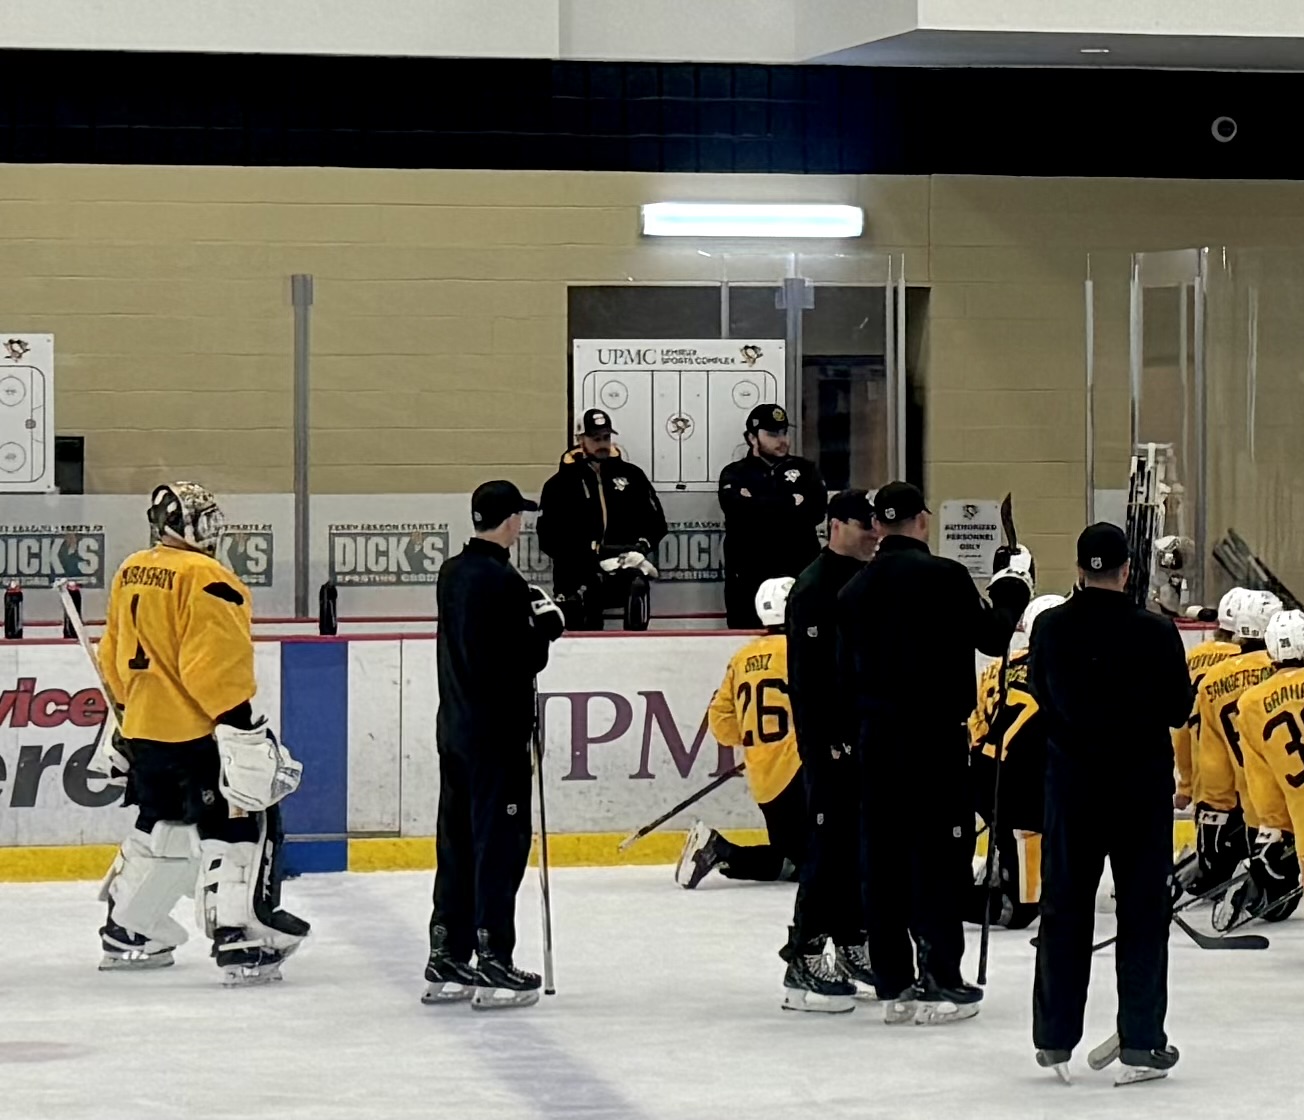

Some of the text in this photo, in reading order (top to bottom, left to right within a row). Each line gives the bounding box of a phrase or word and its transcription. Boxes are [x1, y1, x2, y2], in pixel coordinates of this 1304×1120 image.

[596, 349, 657, 365] UPMC
[0, 537, 99, 575] ICK'S
[334, 536, 444, 572] DICK'S
[658, 532, 726, 570] DICK
[128, 593, 150, 670] 1
[736, 677, 790, 747] 26
